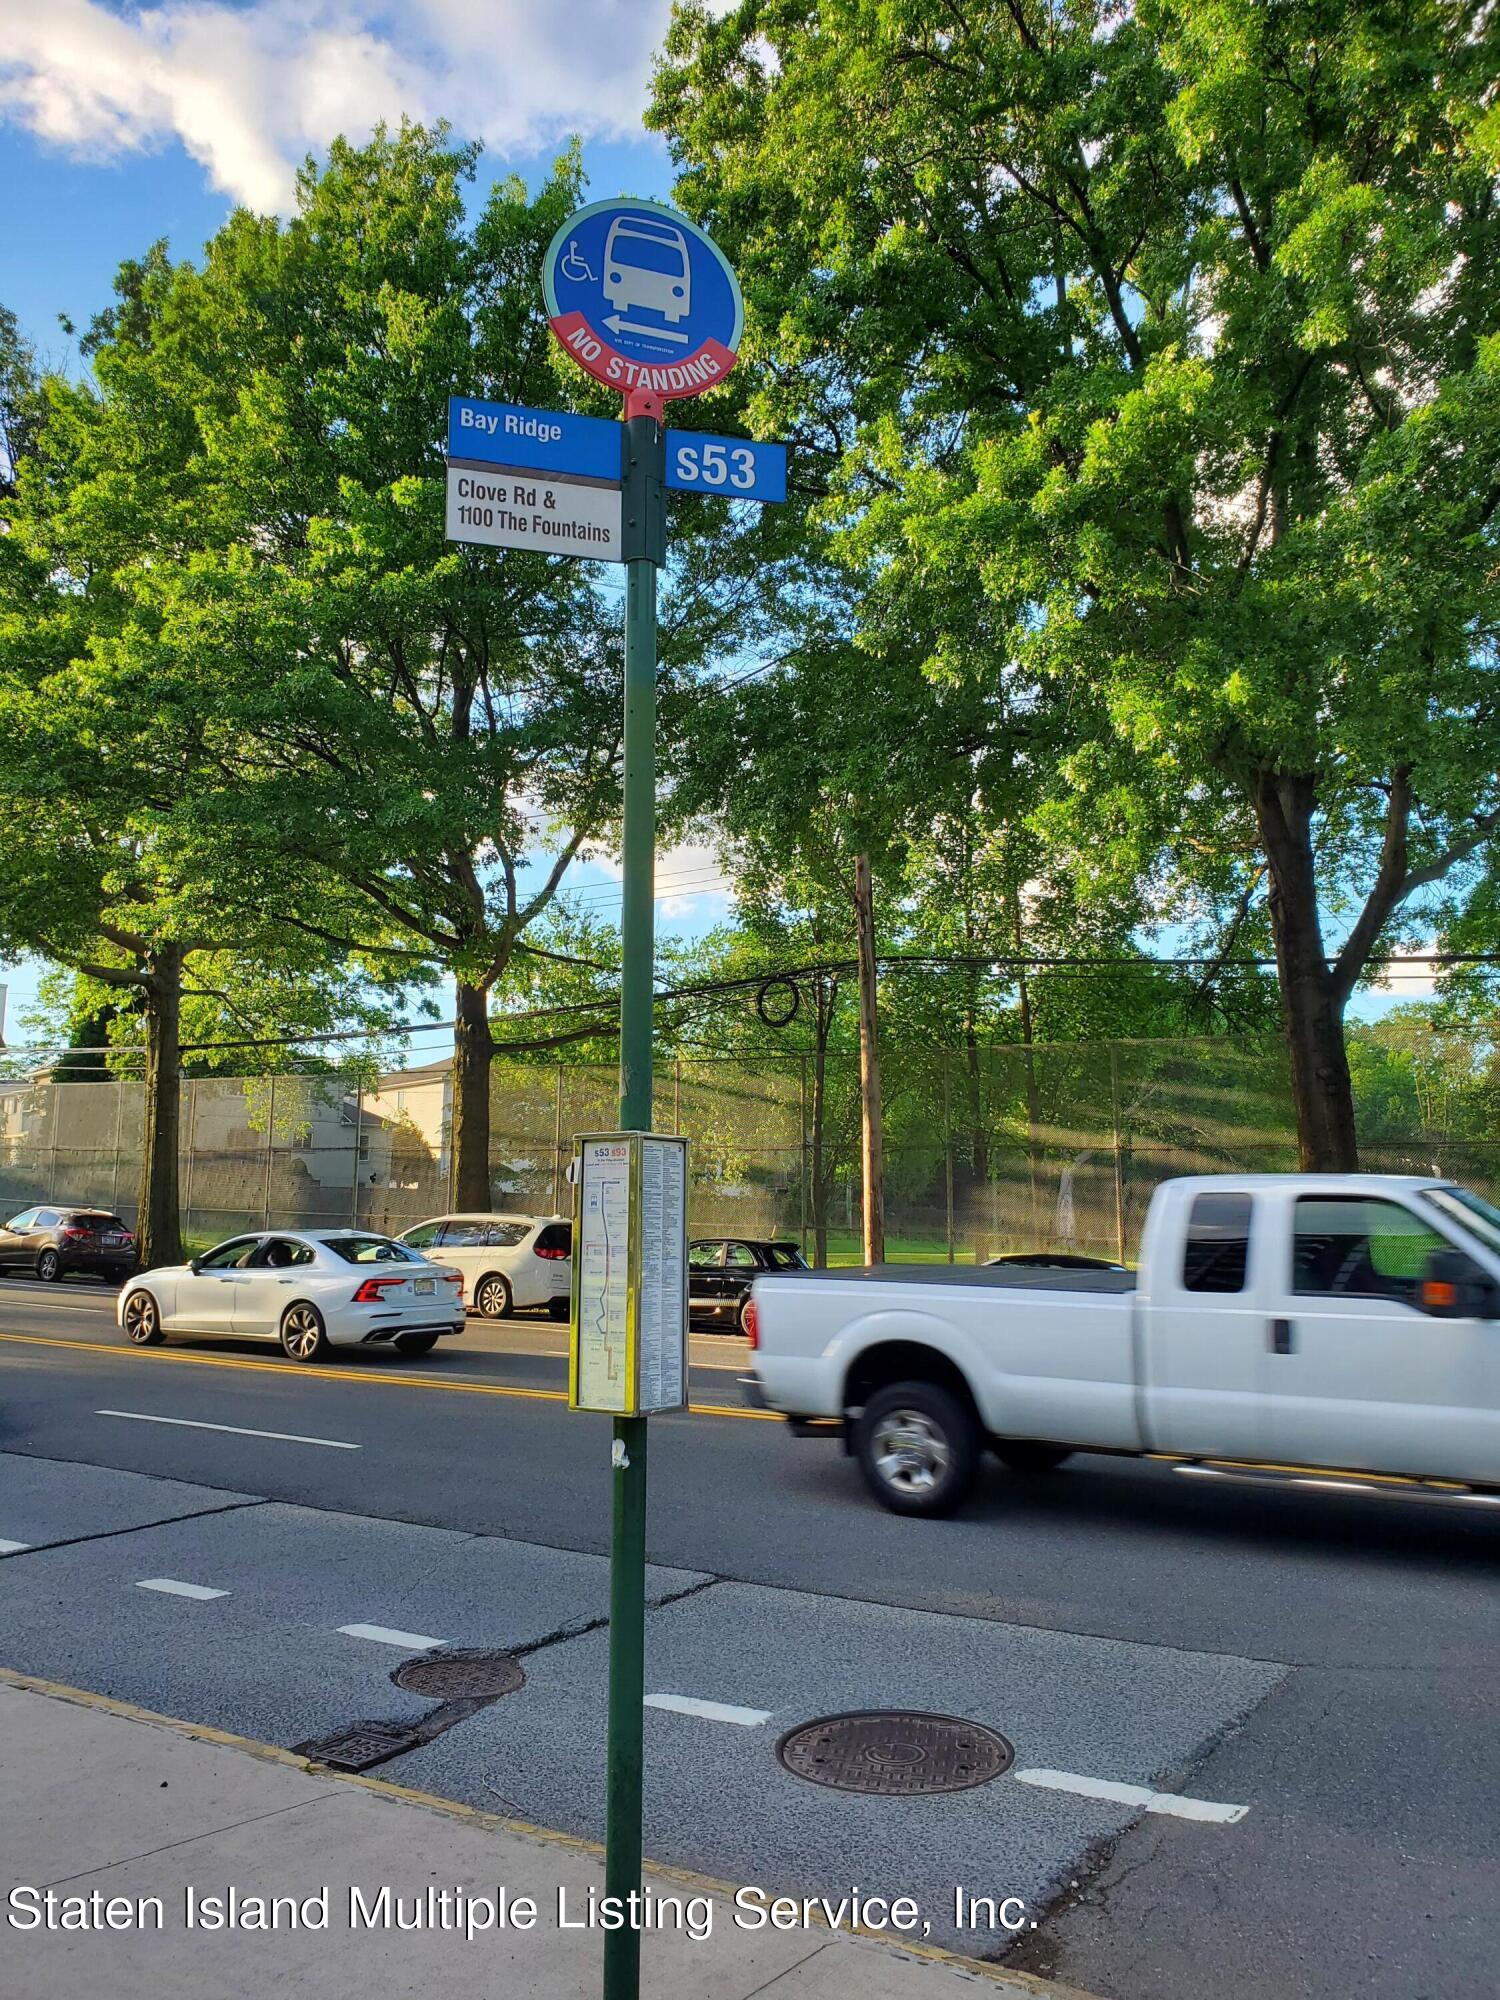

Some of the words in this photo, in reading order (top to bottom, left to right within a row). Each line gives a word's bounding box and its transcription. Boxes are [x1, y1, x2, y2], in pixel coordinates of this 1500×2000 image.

[567, 327, 602, 362] NO
[606, 352, 721, 391] STANDING
[460, 407, 498, 435] Bay
[505, 414, 562, 443] Ridge
[676, 443, 756, 489] S53
[458, 478, 507, 503] Clove
[513, 486, 537, 507] Rd
[543, 490, 556, 510] &
[458, 505, 493, 527] 1100
[498, 510, 528, 532] The
[532, 515, 611, 543] Fountains
